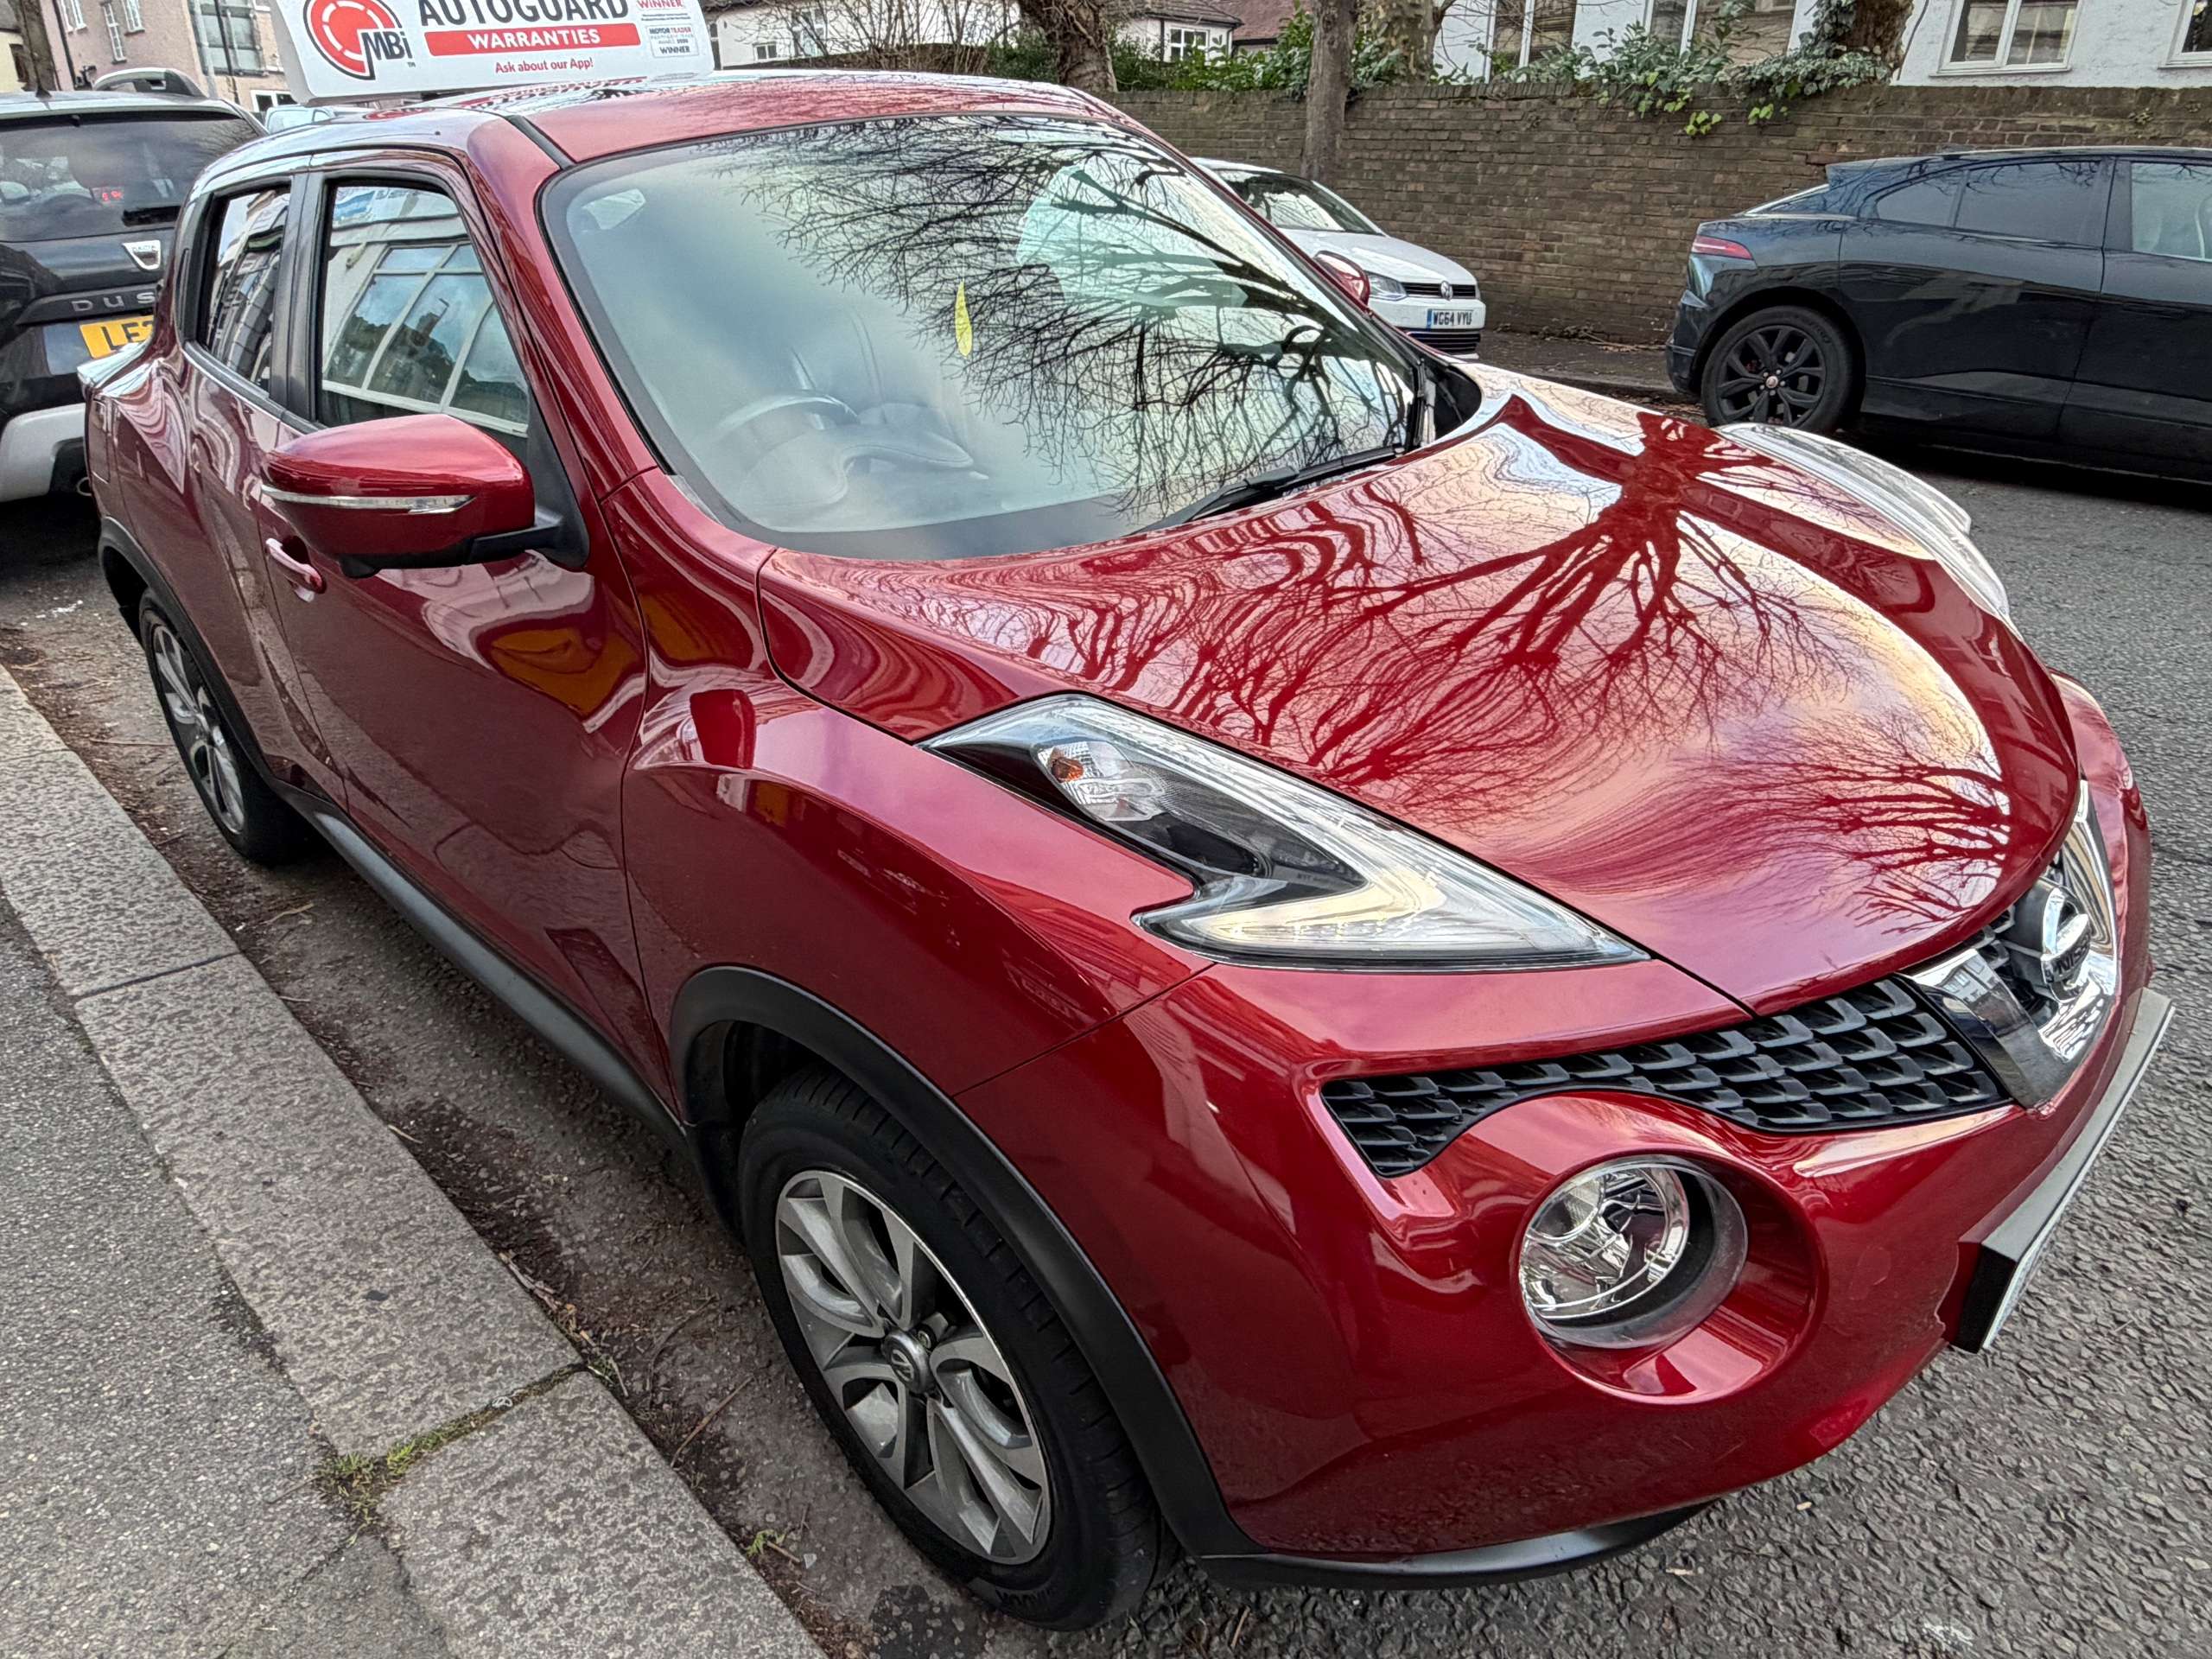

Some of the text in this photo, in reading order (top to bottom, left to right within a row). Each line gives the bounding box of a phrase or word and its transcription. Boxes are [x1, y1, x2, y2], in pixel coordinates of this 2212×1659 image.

[638, 0, 683, 9] WINNER
[418, 0, 629, 27] AUTOGUARD
[467, 28, 601, 49] WARRANTIES
[659, 46, 690, 54] WINNER
[495, 57, 594, 74] Ask about our App!
